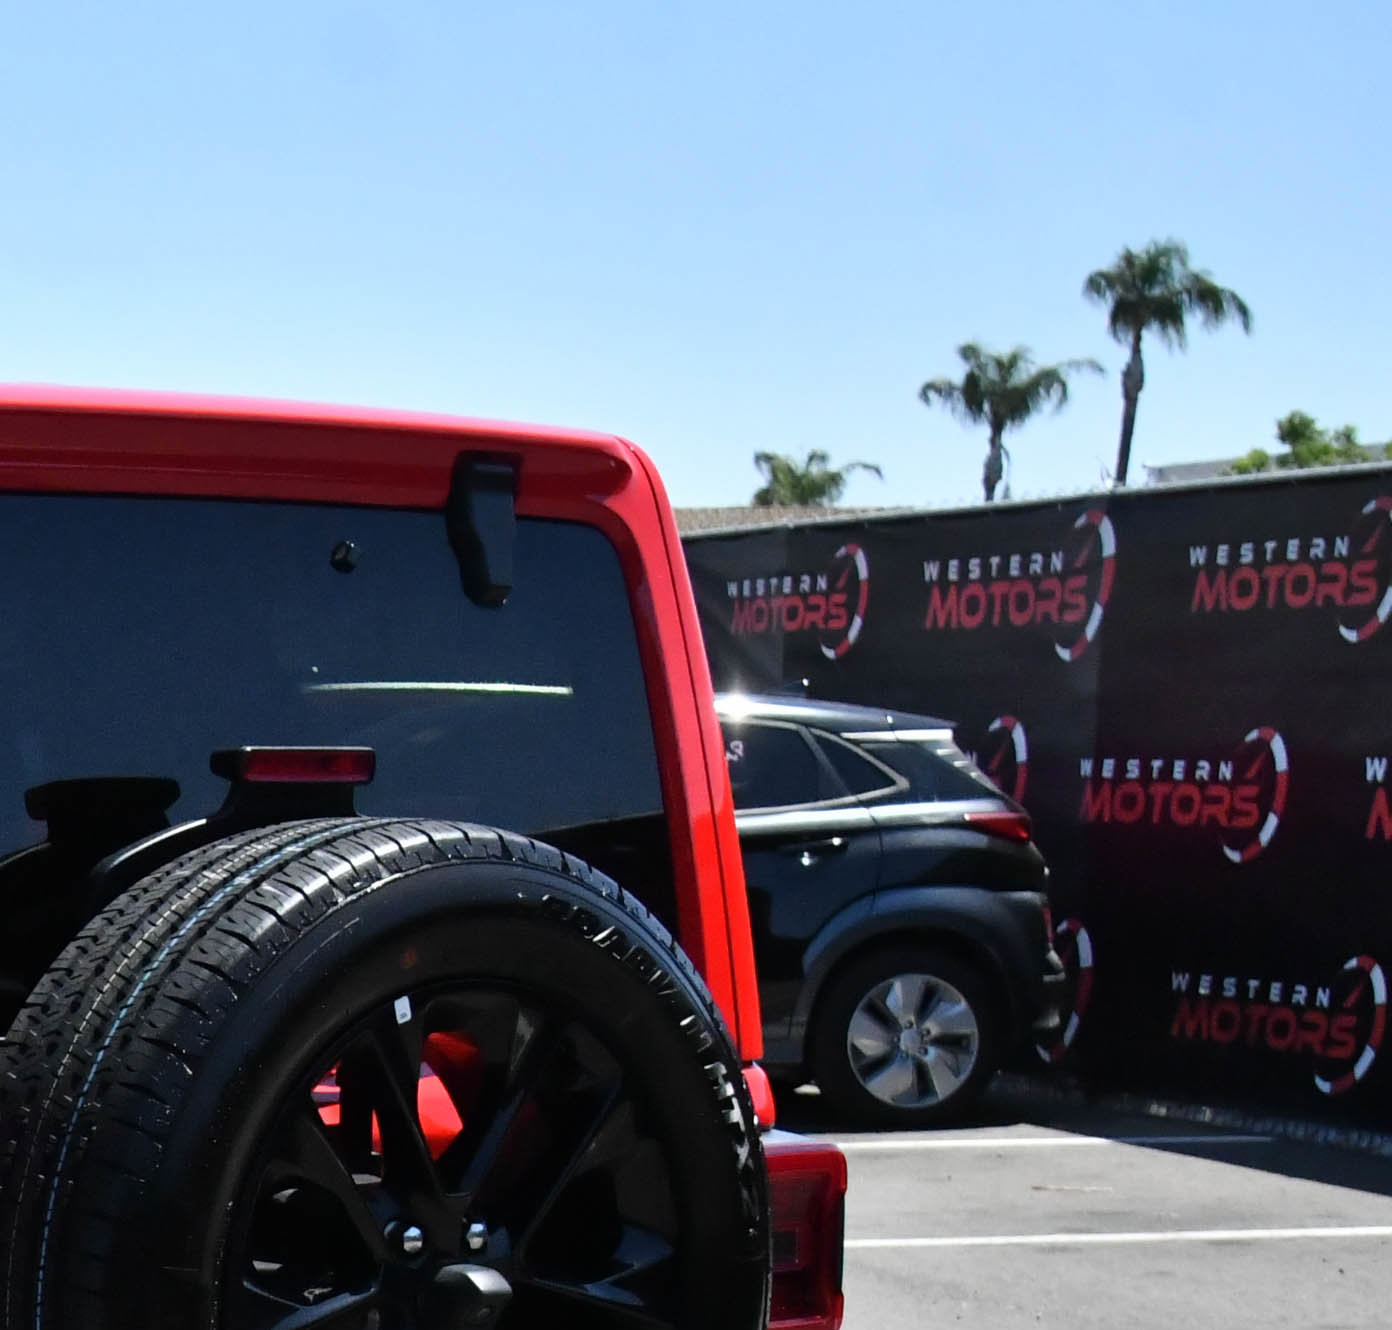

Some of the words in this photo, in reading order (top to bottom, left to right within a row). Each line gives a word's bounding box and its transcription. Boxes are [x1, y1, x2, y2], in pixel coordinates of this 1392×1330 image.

[923, 551, 1065, 583] WESTERN
[1189, 536, 1350, 566] WESTERN
[727, 574, 828, 598] WESTERN
[925, 575, 1088, 630] MOTORS
[1191, 560, 1378, 613] MOTORS
[731, 593, 849, 635] MOTORS
[1080, 758, 1234, 781] WESTERN
[1079, 780, 1260, 828] MOTORS
[1171, 971, 1331, 1008] WESTERN
[1171, 998, 1357, 1059] MOTORS
